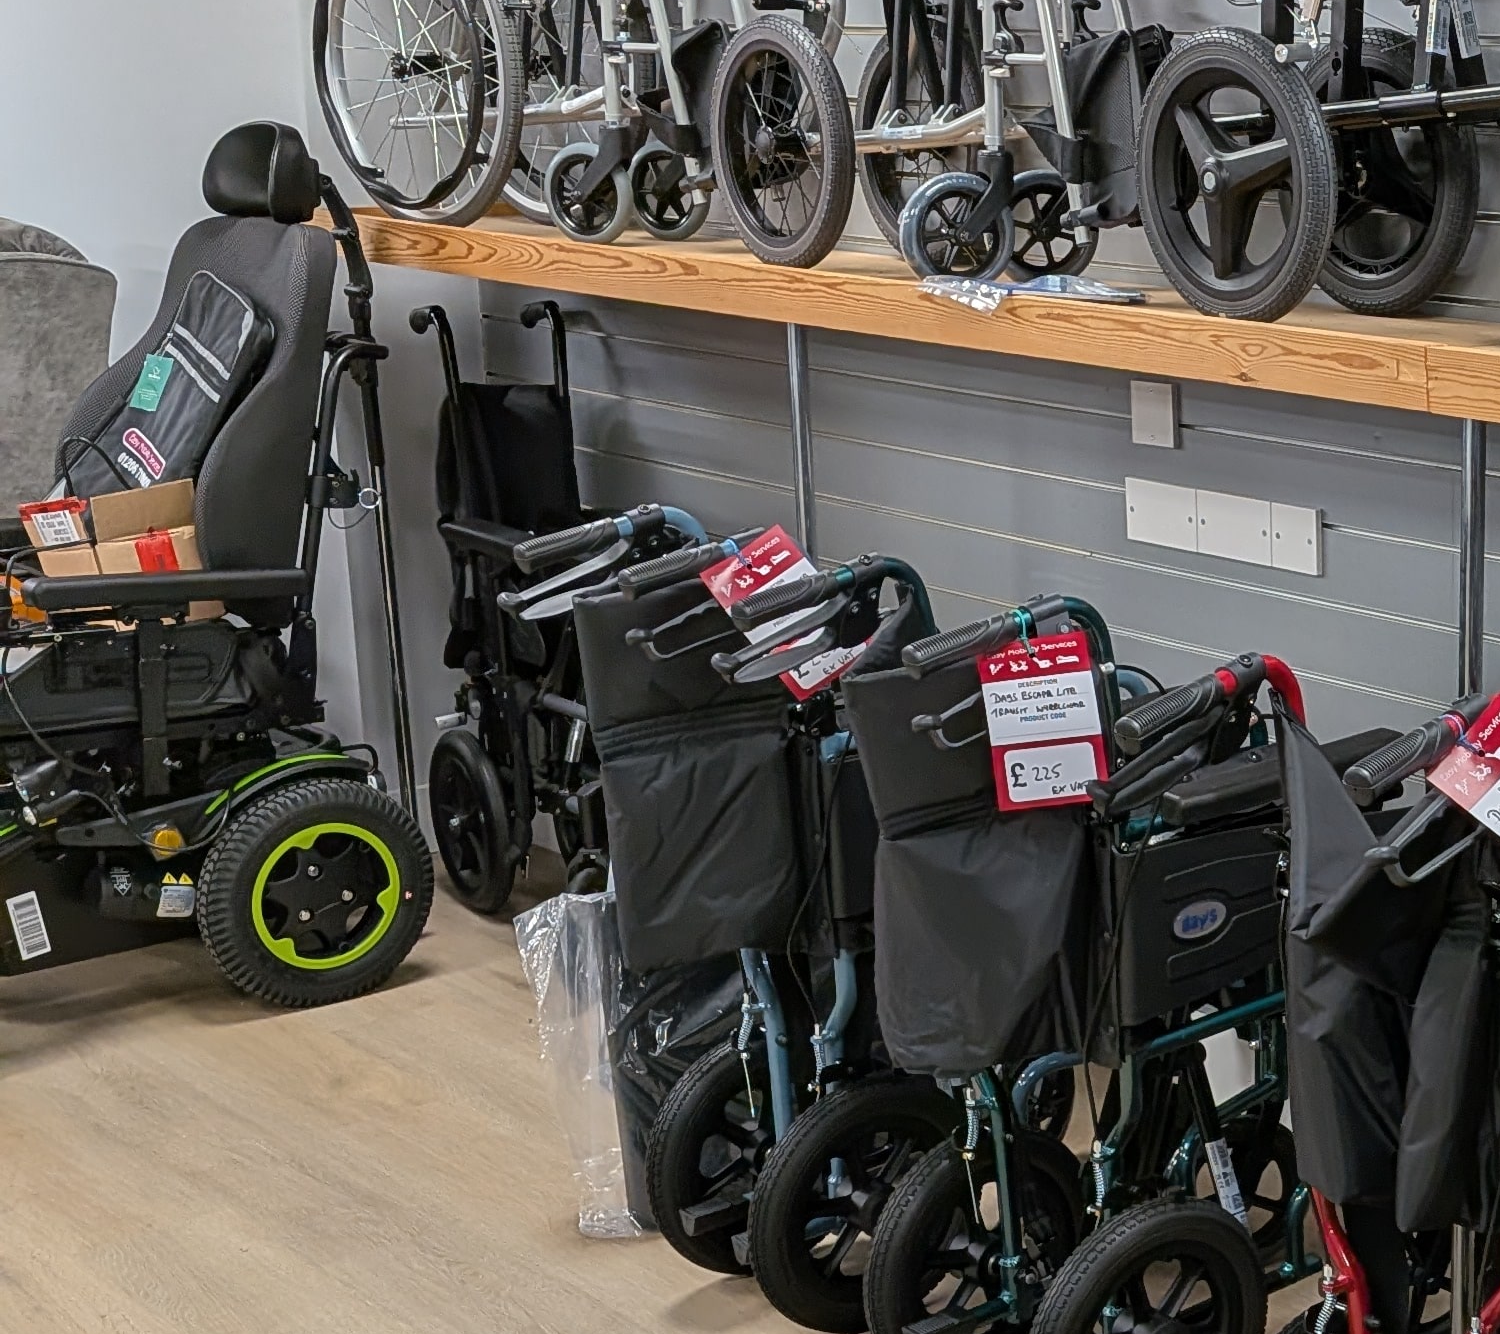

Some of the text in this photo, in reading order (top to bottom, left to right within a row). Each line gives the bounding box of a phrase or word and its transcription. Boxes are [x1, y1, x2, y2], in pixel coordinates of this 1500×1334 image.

[751, 536, 781, 558] Services
[1041, 640, 1077, 651] Services
[822, 663, 836, 675] EX
[837, 649, 855, 665] VAT
[1057, 686, 1077, 696] LITE
[991, 707, 1028, 718] TRANSIT
[1020, 712, 1067, 723] PRODUCT CODE
[1010, 762, 1062, 788] £ 225
[1051, 785, 1067, 795] EX
